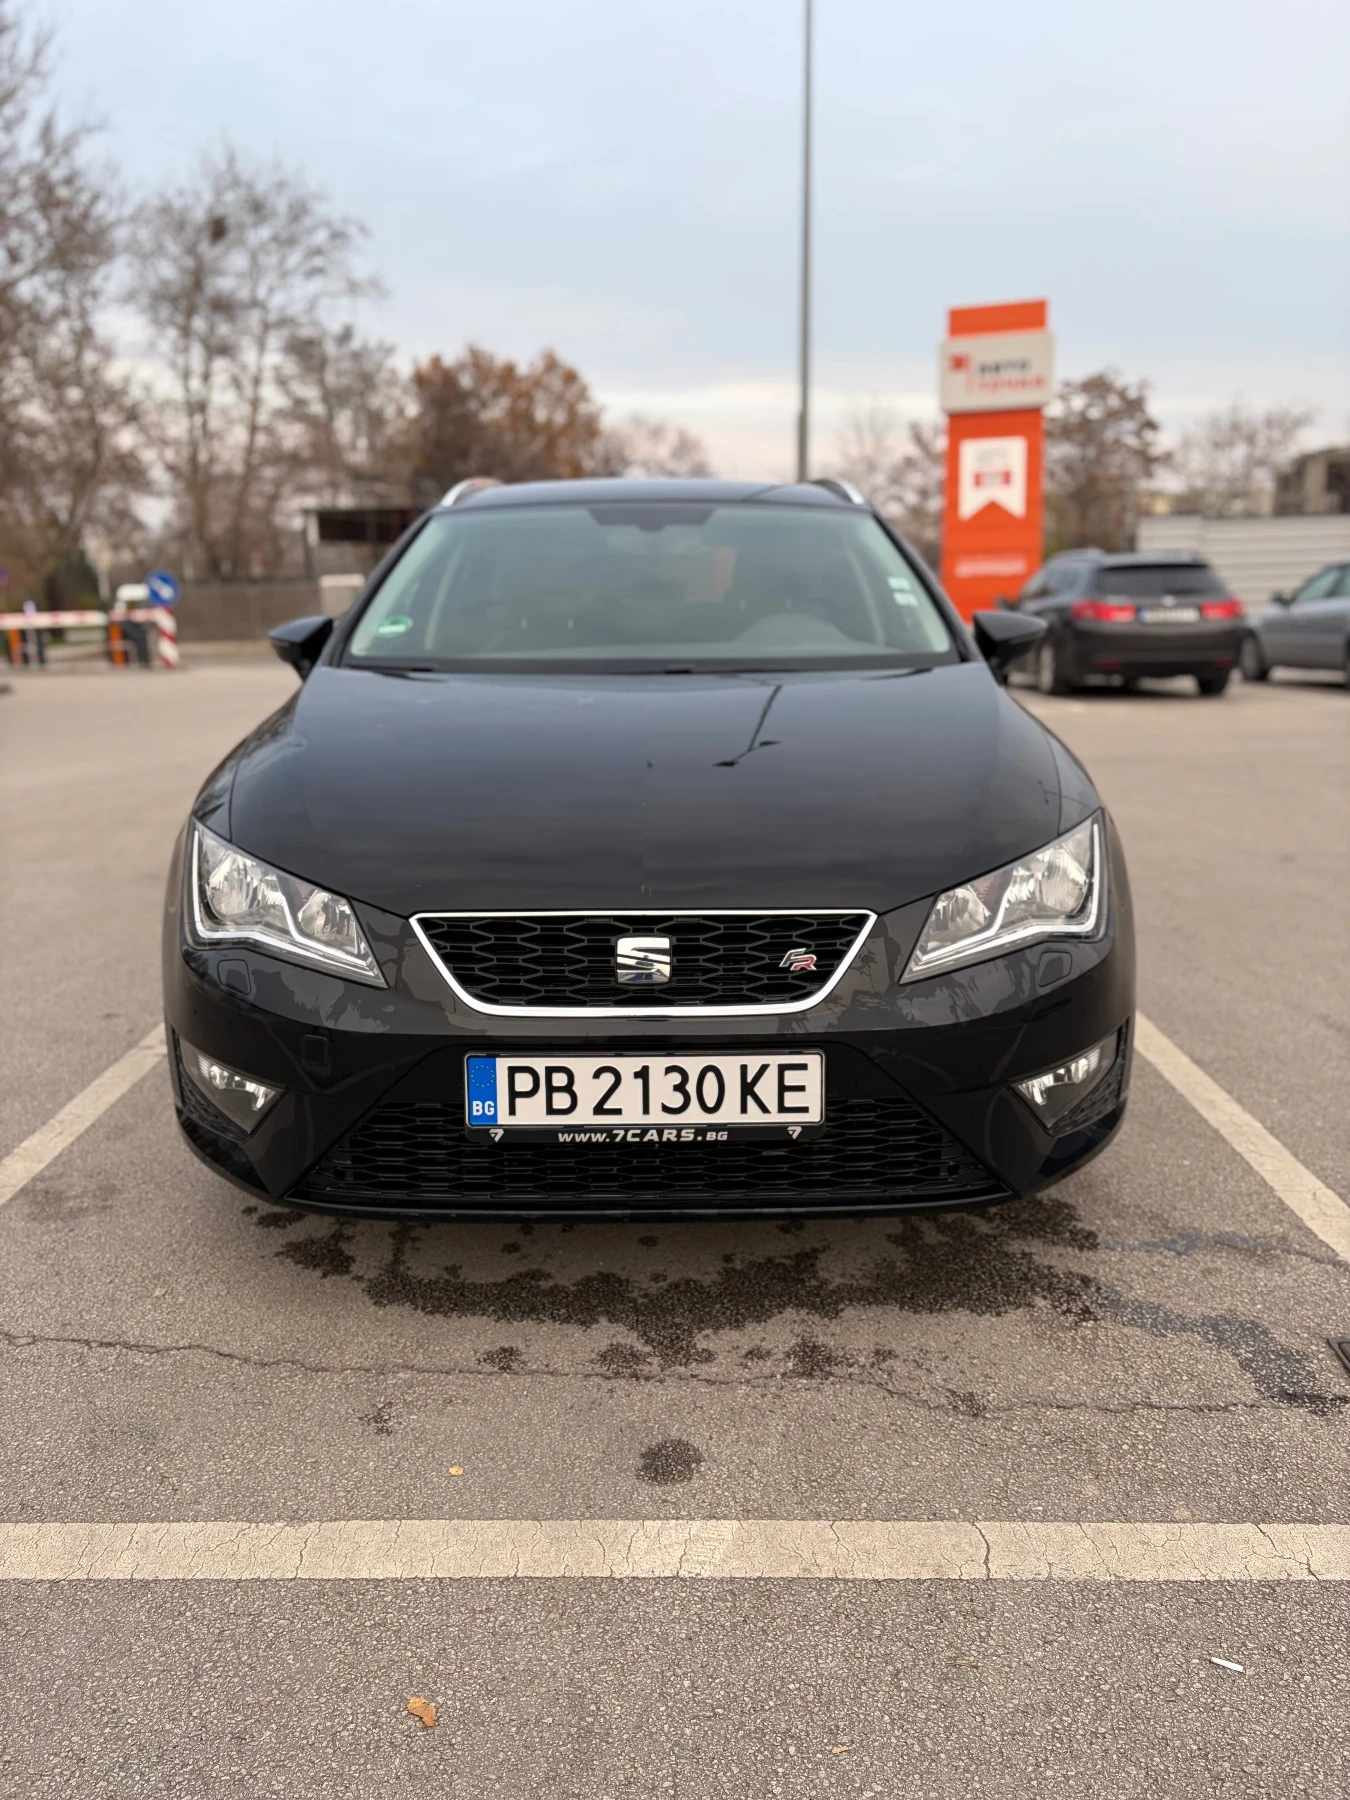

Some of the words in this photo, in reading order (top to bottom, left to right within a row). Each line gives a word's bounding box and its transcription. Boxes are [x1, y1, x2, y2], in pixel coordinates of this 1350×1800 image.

[779, 948, 817, 971] FR
[507, 1065, 578, 1116] PB
[592, 1064, 725, 1115] 2130
[739, 1063, 809, 1114] KE
[472, 1101, 495, 1115] BG
